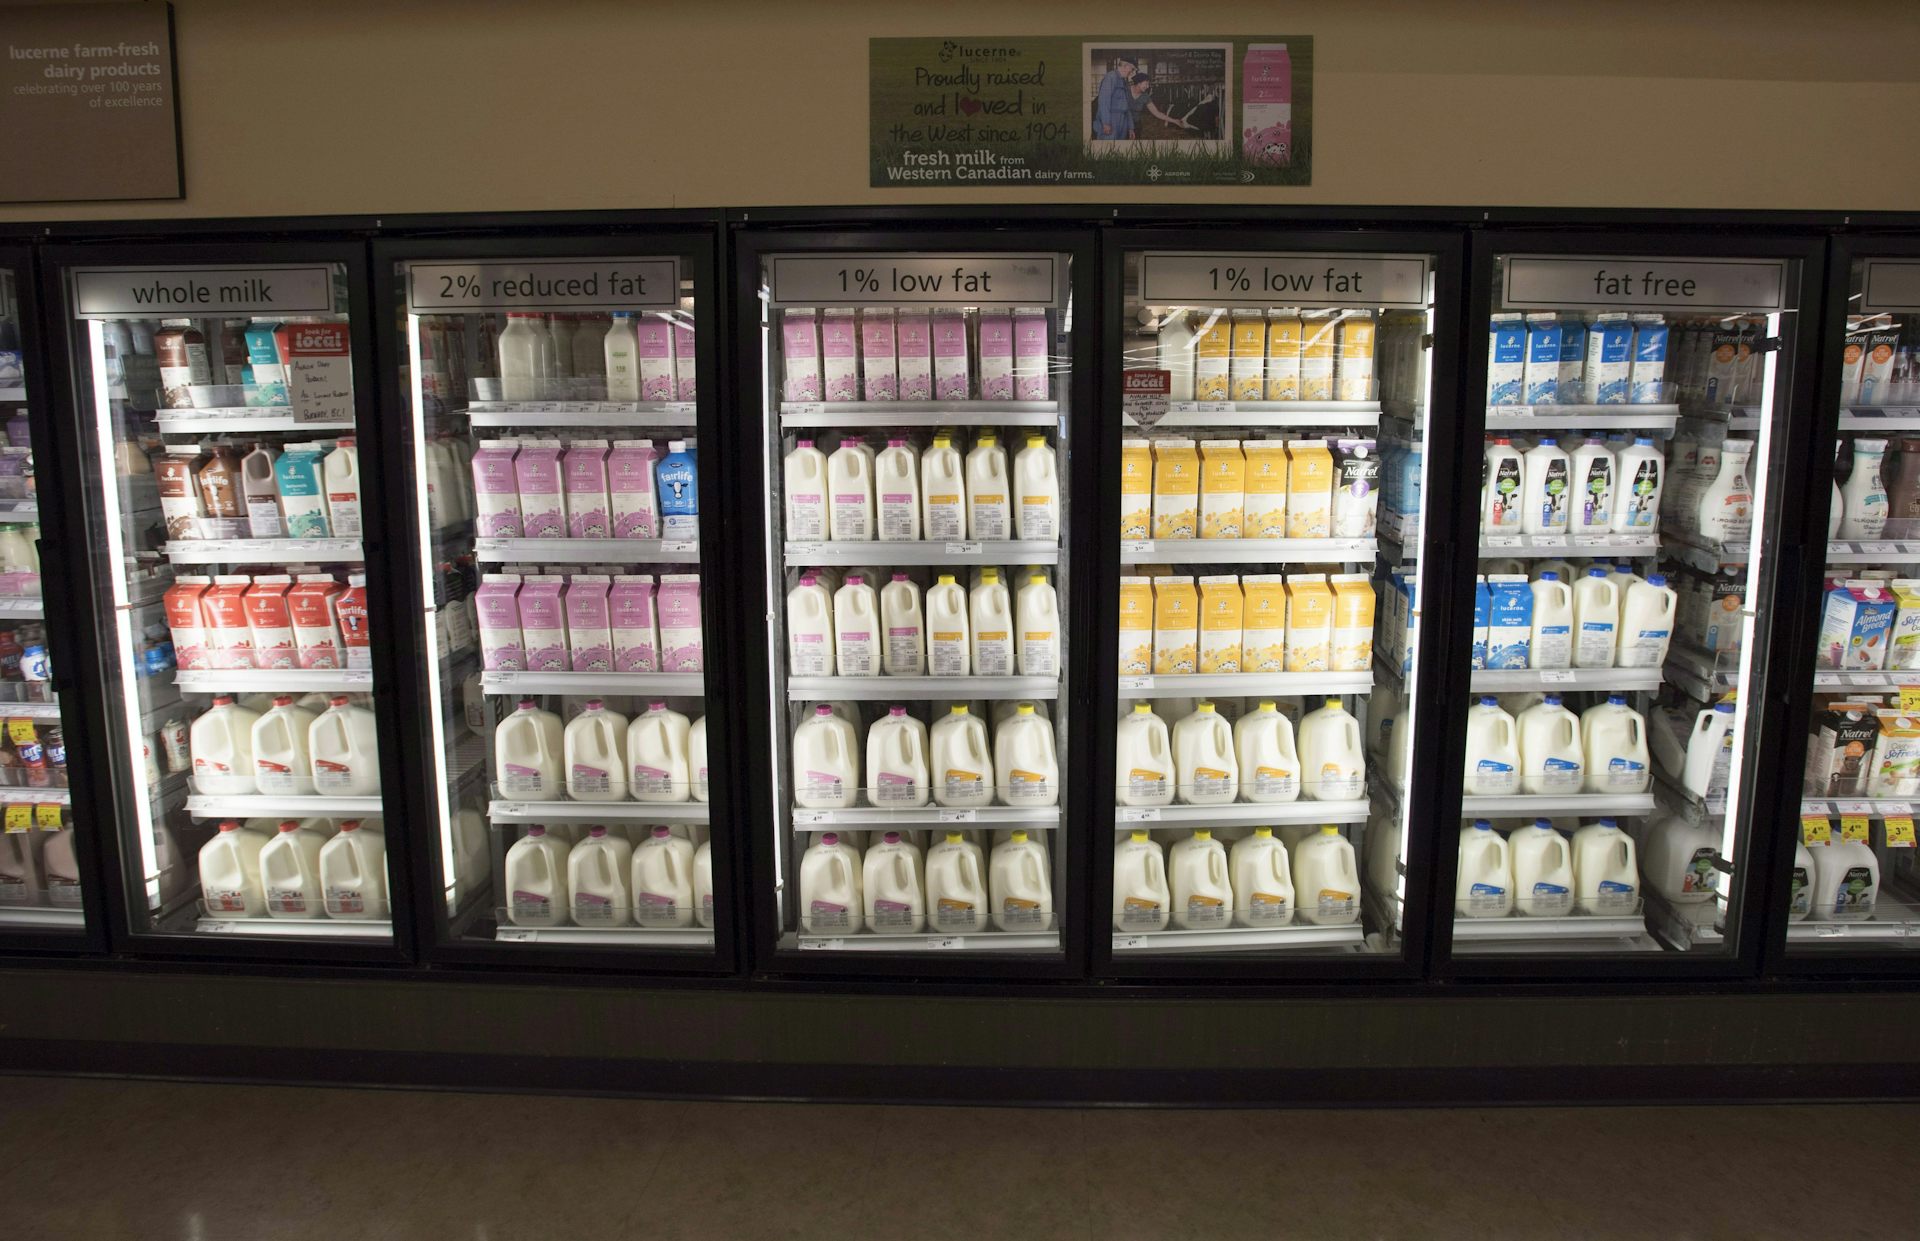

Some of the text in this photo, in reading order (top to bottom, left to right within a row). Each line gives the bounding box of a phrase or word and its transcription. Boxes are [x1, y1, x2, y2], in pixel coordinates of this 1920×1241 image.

[9, 41, 160, 60] lucerne farm-fresh
[44, 62, 161, 80] dairy products
[914, 60, 1045, 95] Proudly raised
[13, 81, 162, 96] celebrating over 100 years
[89, 96, 164, 108] of excellence
[913, 95, 946, 116] and
[1032, 97, 1046, 115] in
[890, 122, 1070, 143] the West since 1904
[904, 149, 1025, 166] fresh milk from
[887, 166, 1096, 182] Western Canadian dairy farms.
[440, 272, 647, 298] 2% reduced fat
[838, 268, 992, 293] 1% low fat
[1209, 267, 1363, 293] 1% low fat
[1594, 270, 1697, 297] fat free
[133, 279, 273, 304] whole milk
[296, 332, 342, 348] local
[1872, 334, 1897, 342] Natrel
[1126, 376, 1164, 388] local
[661, 471, 694, 482] fairlife
[1344, 466, 1378, 476] Natrel
[1855, 610, 1892, 628] Almond
[1861, 620, 1886, 634] Breeze
[1840, 729, 1874, 738] Natrel
